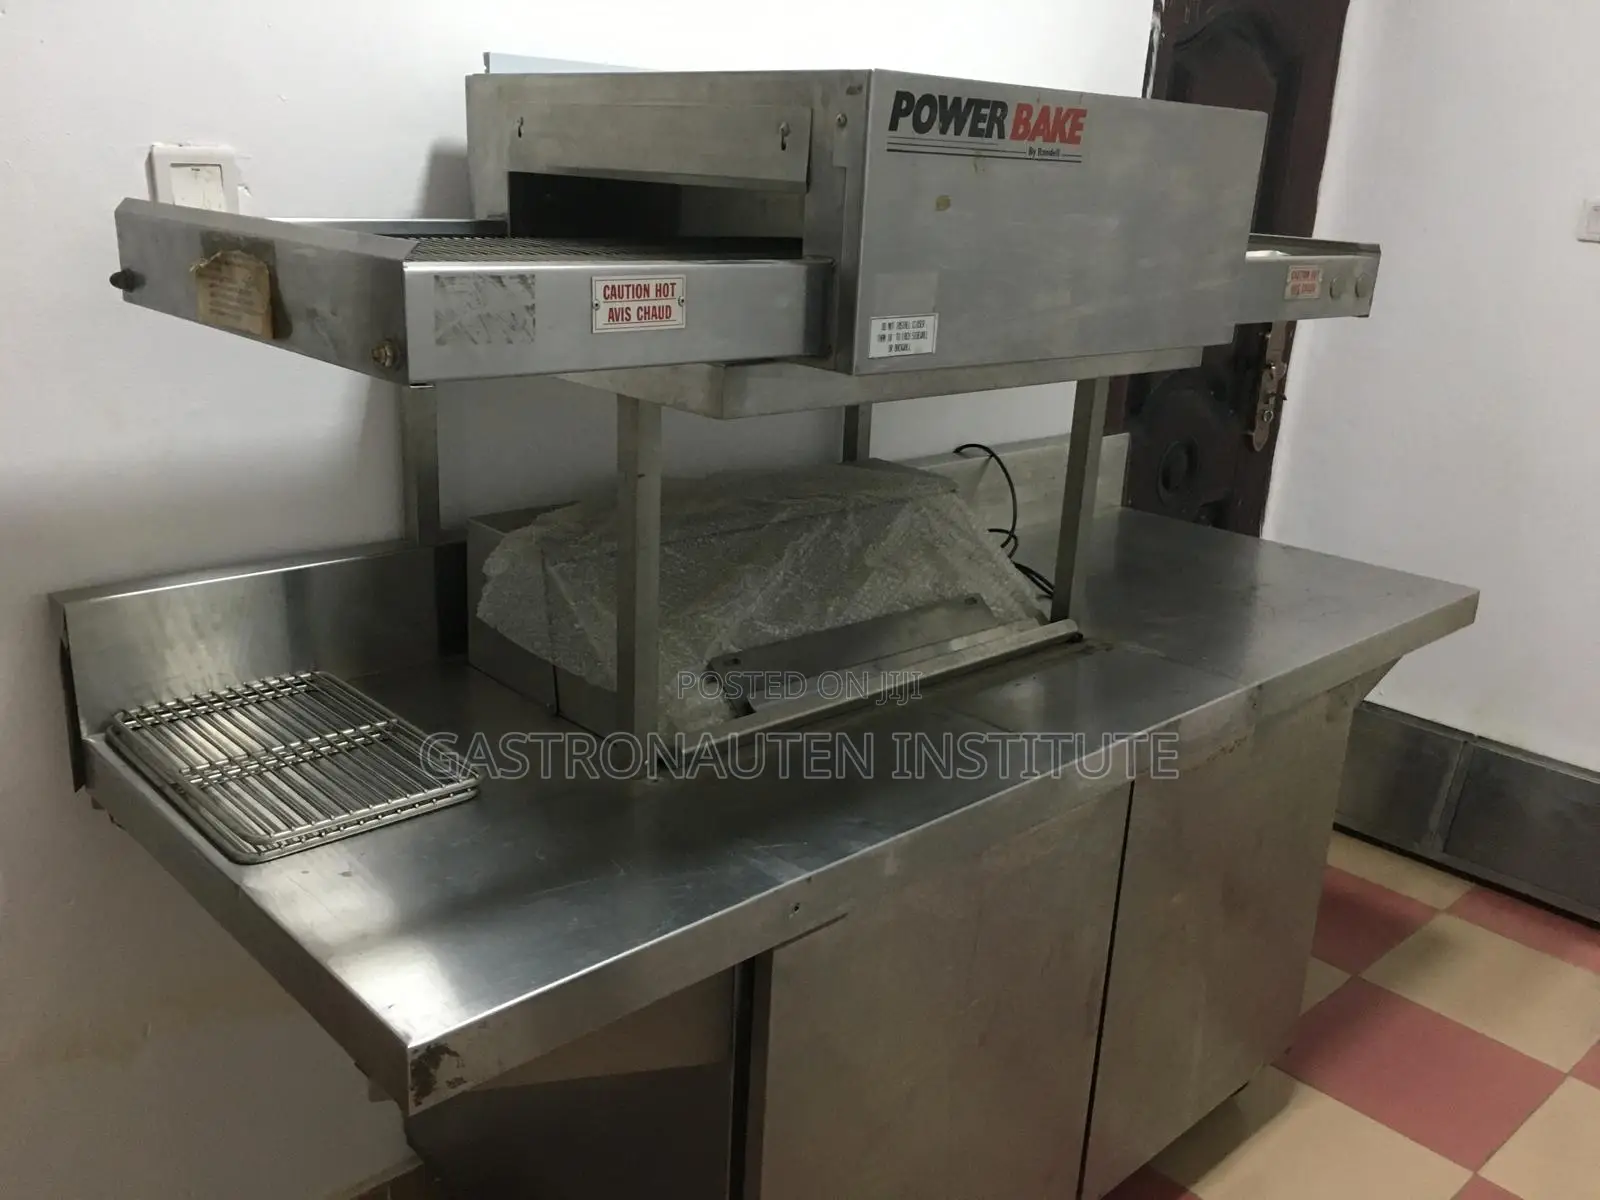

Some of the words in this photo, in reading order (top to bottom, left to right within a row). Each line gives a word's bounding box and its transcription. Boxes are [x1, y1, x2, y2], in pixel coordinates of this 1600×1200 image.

[888, 90, 1009, 140] POWER
[1009, 102, 1088, 145] BAKE
[603, 284, 650, 300] CAUTION
[655, 282, 677, 298] HOT
[608, 306, 632, 322] AVIS
[636, 305, 672, 321] CHAUD
